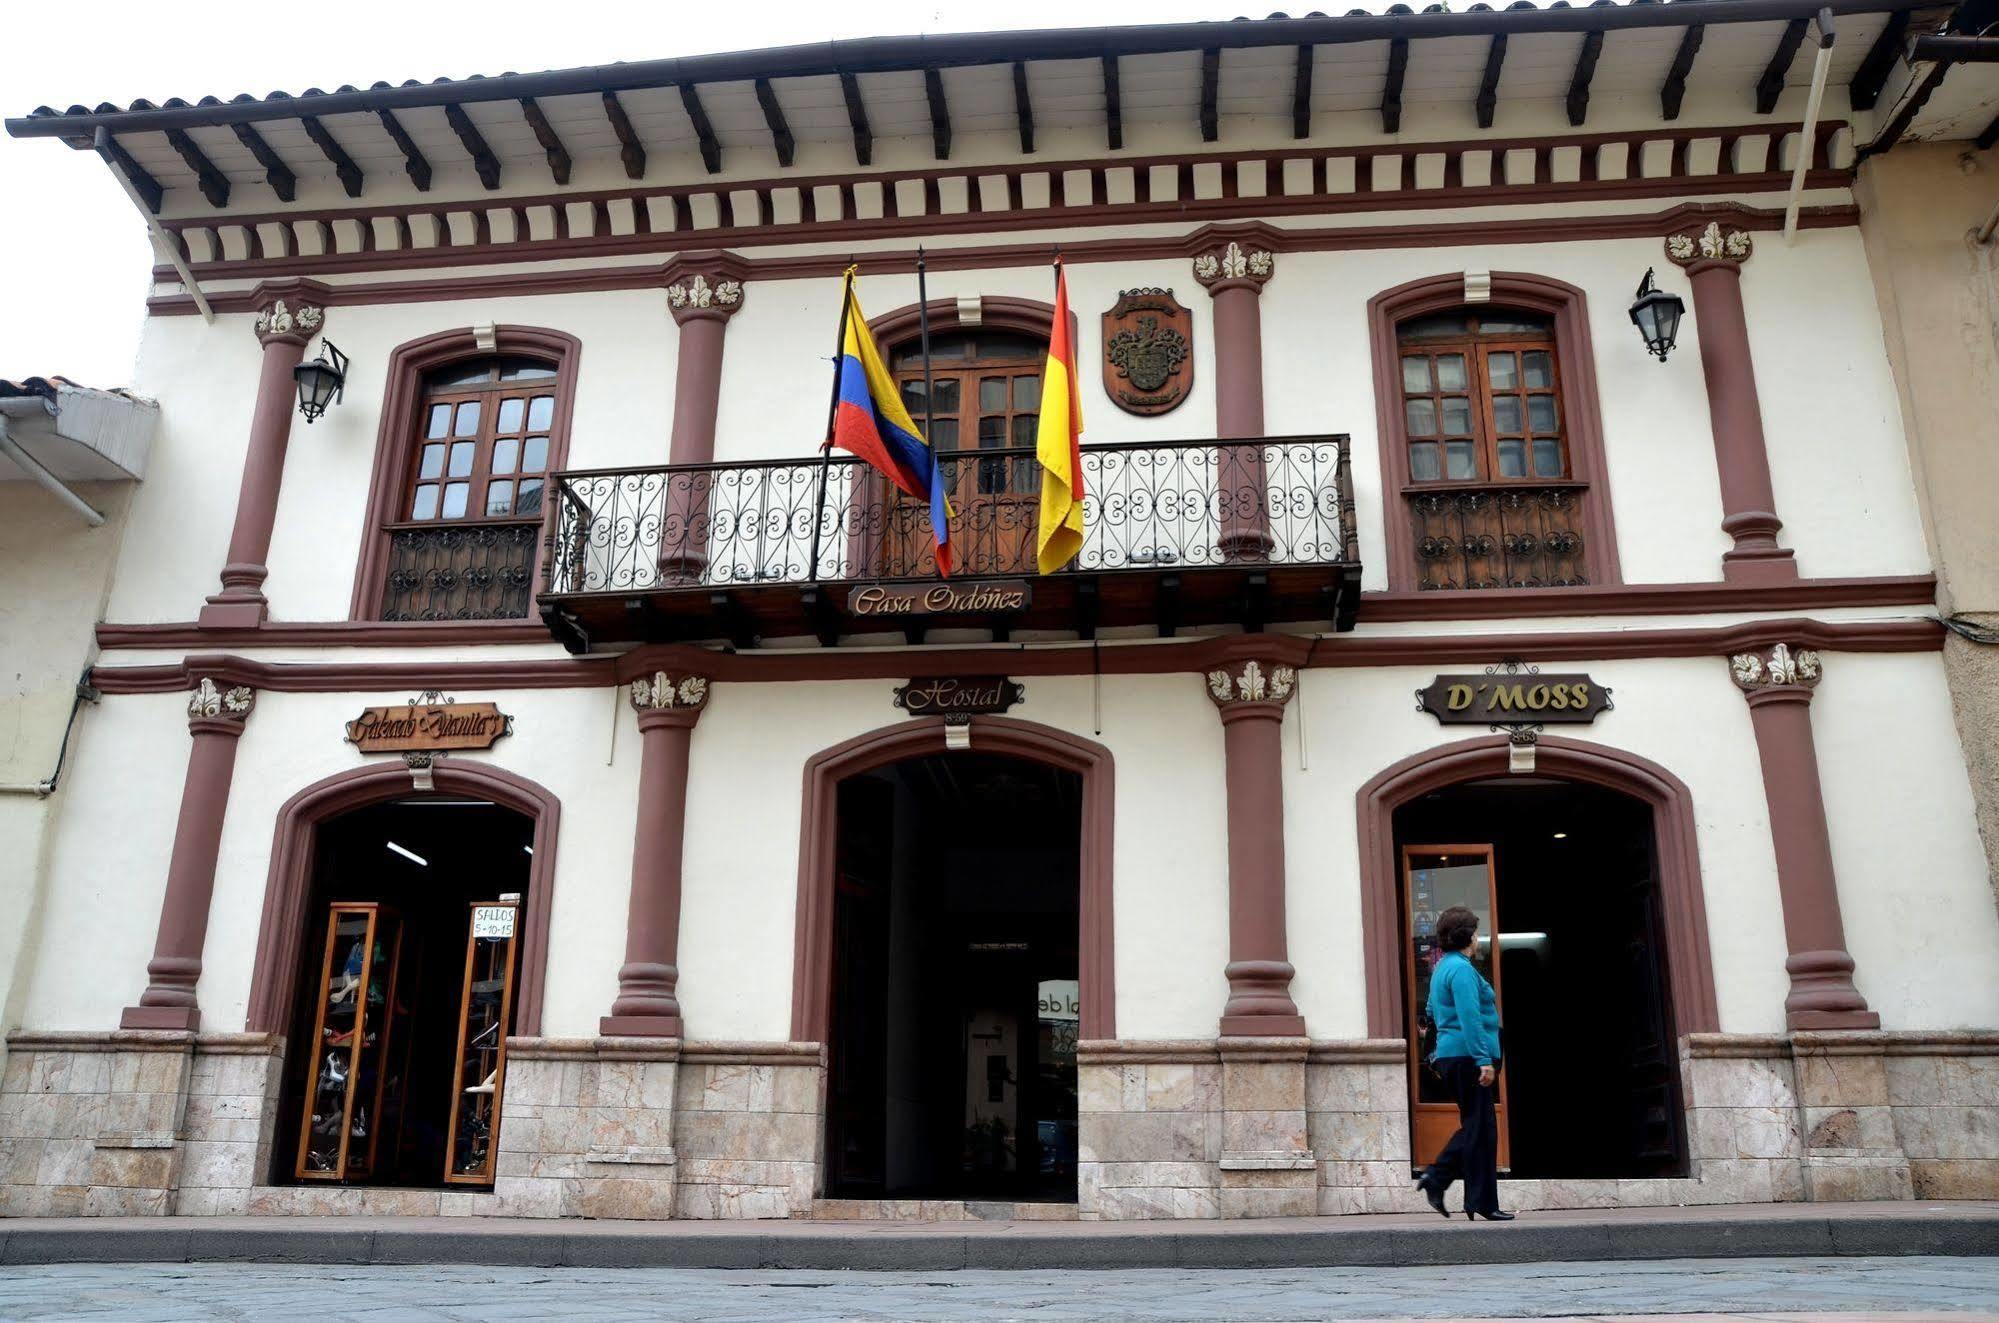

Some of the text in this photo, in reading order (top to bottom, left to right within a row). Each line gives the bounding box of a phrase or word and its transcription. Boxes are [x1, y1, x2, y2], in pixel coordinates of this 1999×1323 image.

[856, 584, 1024, 614] Casa Ordóñez
[905, 680, 1002, 709] Hostal
[354, 707, 416, 742] Calzado
[475, 923, 512, 935] 5-10-15
